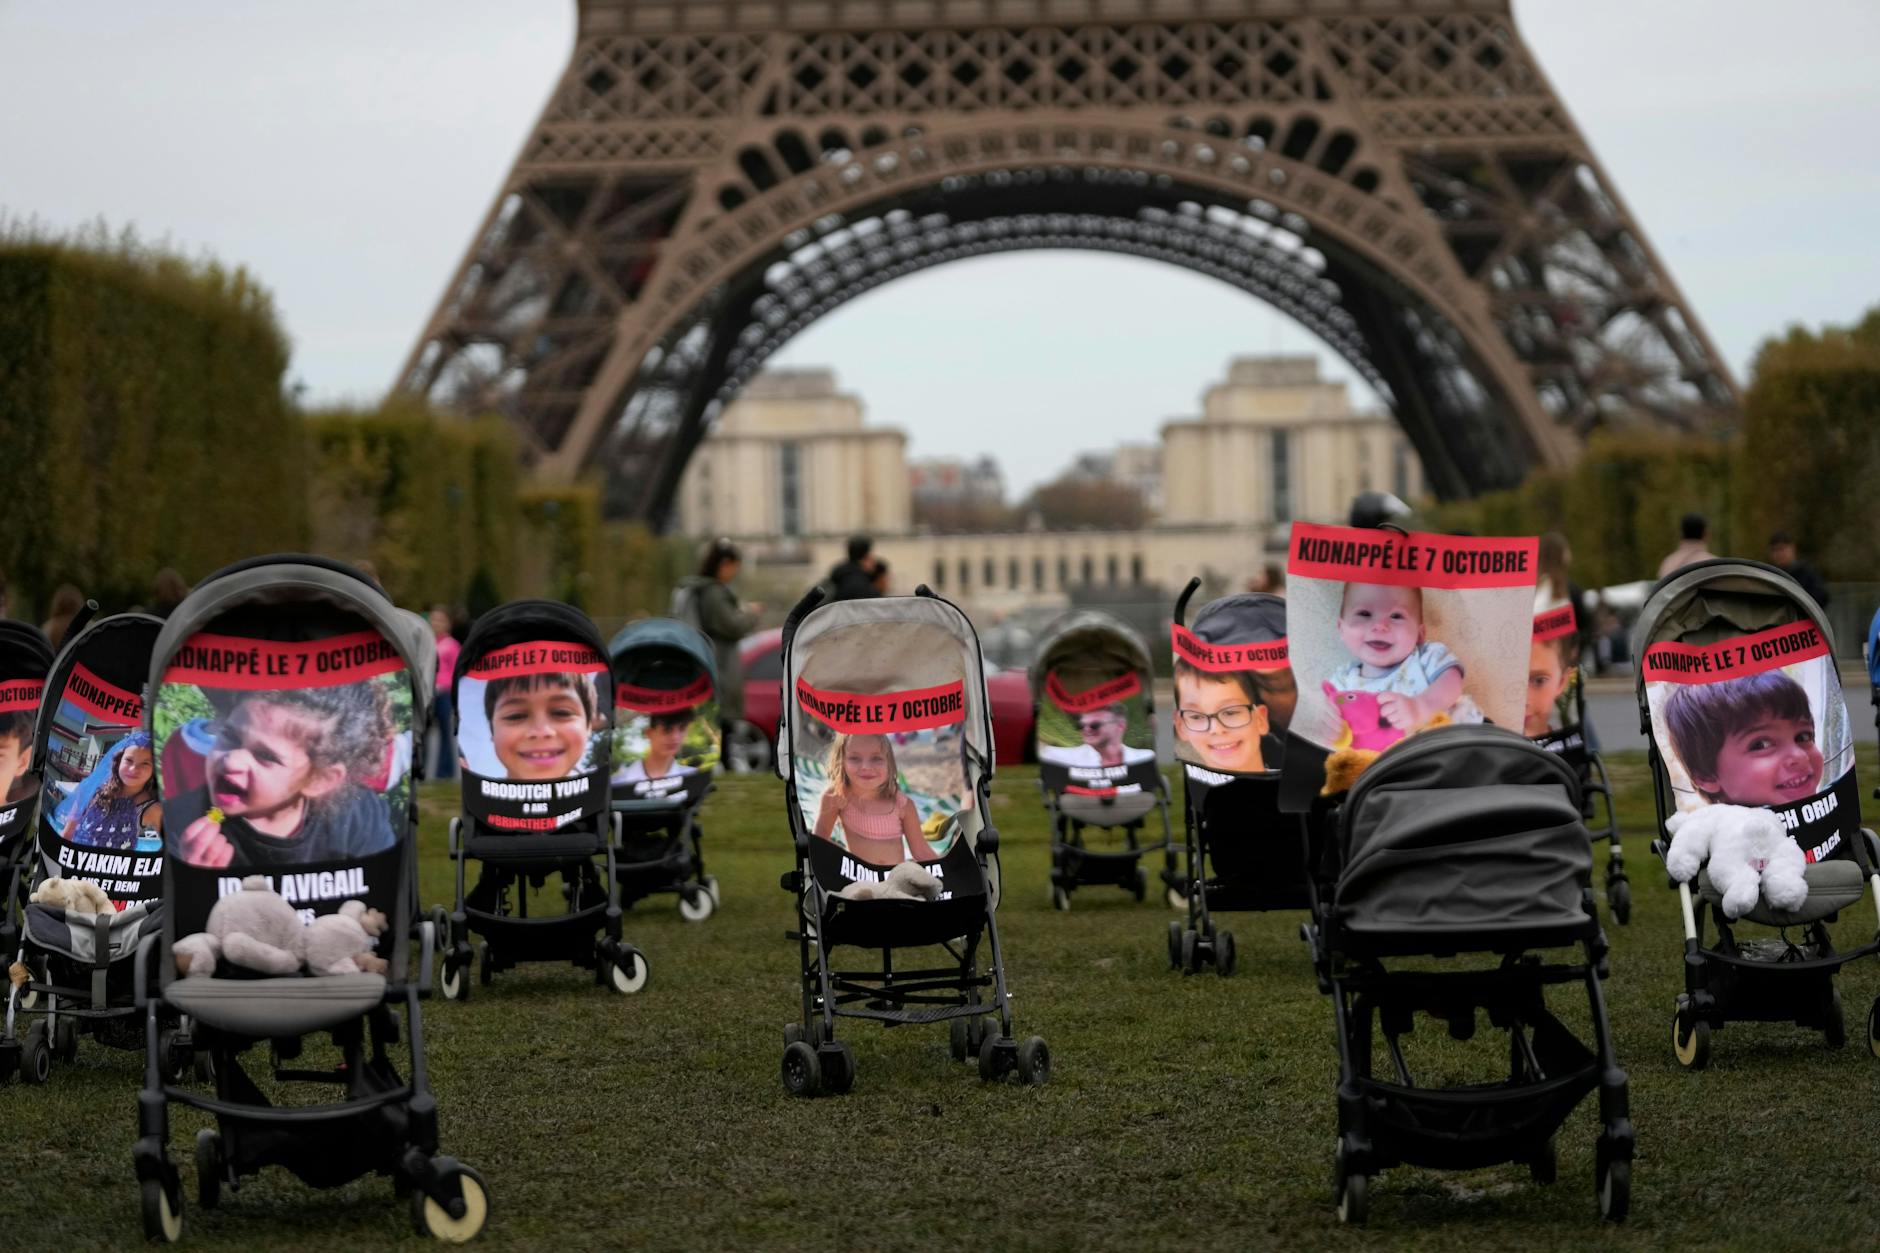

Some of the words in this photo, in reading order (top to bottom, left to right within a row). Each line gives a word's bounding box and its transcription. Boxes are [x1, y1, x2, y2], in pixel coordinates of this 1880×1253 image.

[1298, 537, 1393, 569] KIDNAPPÉ
[1397, 546, 1418, 571] LE
[1425, 547, 1437, 572] 7
[1443, 549, 1529, 575] OCTOBRE
[522, 651, 536, 665] LE
[540, 649, 548, 663] 7
[1176, 632, 1214, 664] KIDNAPPÉ
[1216, 651, 1232, 664] LE
[1234, 651, 1242, 663] 7
[1648, 652, 1712, 673] KIDNAPPÉ
[1714, 650, 1734, 670] LE
[1736, 647, 1745, 665] 7
[1750, 628, 1820, 661] OCTOBRE
[267, 653, 288, 675] LE
[296, 654, 308, 674] 7
[0, 687, 42, 704] OCTOBR
[69, 673, 140, 719] KIDNAPPÉE
[798, 687, 862, 723] KIDNAPPÉE
[866, 705, 883, 723] LE
[888, 703, 897, 722] 7
[902, 691, 963, 720] OCTOBRE
[481, 780, 552, 799] BRODUTCH
[555, 777, 590, 799] YUVA
[531, 803, 548, 813] ANS
[1801, 792, 1839, 824] ORIA
[58, 845, 131, 876] ELYAKIM
[133, 857, 163, 876] ELA
[101, 880, 114, 891] ET
[114, 880, 140, 893] DEMI
[281, 867, 369, 903] AVIGAIL
